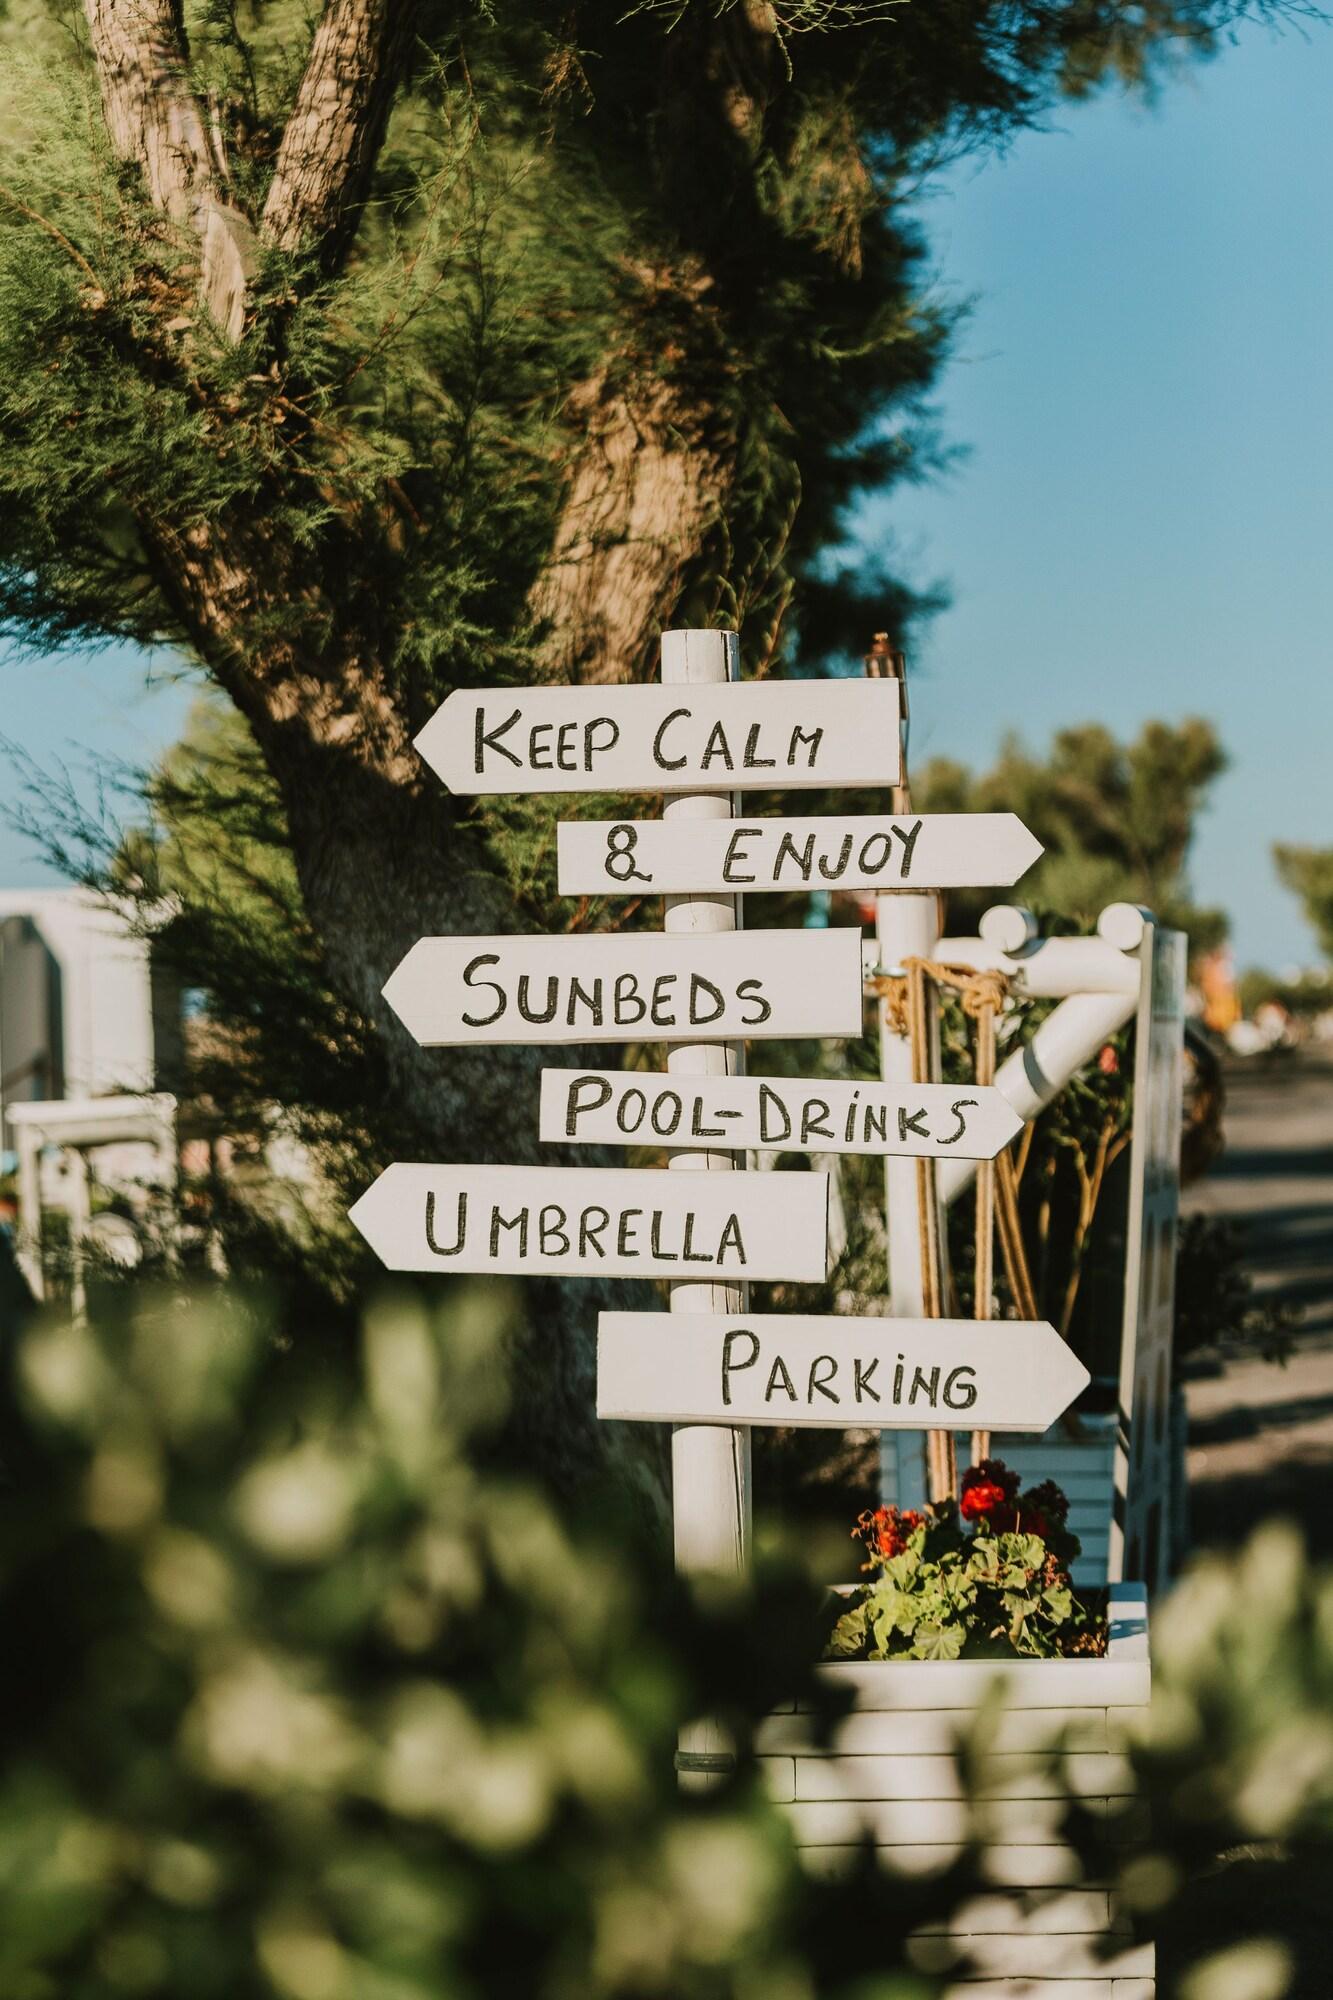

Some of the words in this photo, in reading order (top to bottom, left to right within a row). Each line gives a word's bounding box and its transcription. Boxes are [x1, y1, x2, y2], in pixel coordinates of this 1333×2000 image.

[474, 707, 620, 774] KEEP
[652, 708, 825, 771] CALM
[604, 824, 653, 882] &
[722, 819, 923, 883] ENJOY
[461, 953, 772, 1028] SUNBEDS
[425, 1191, 747, 1265] UMBRELLA
